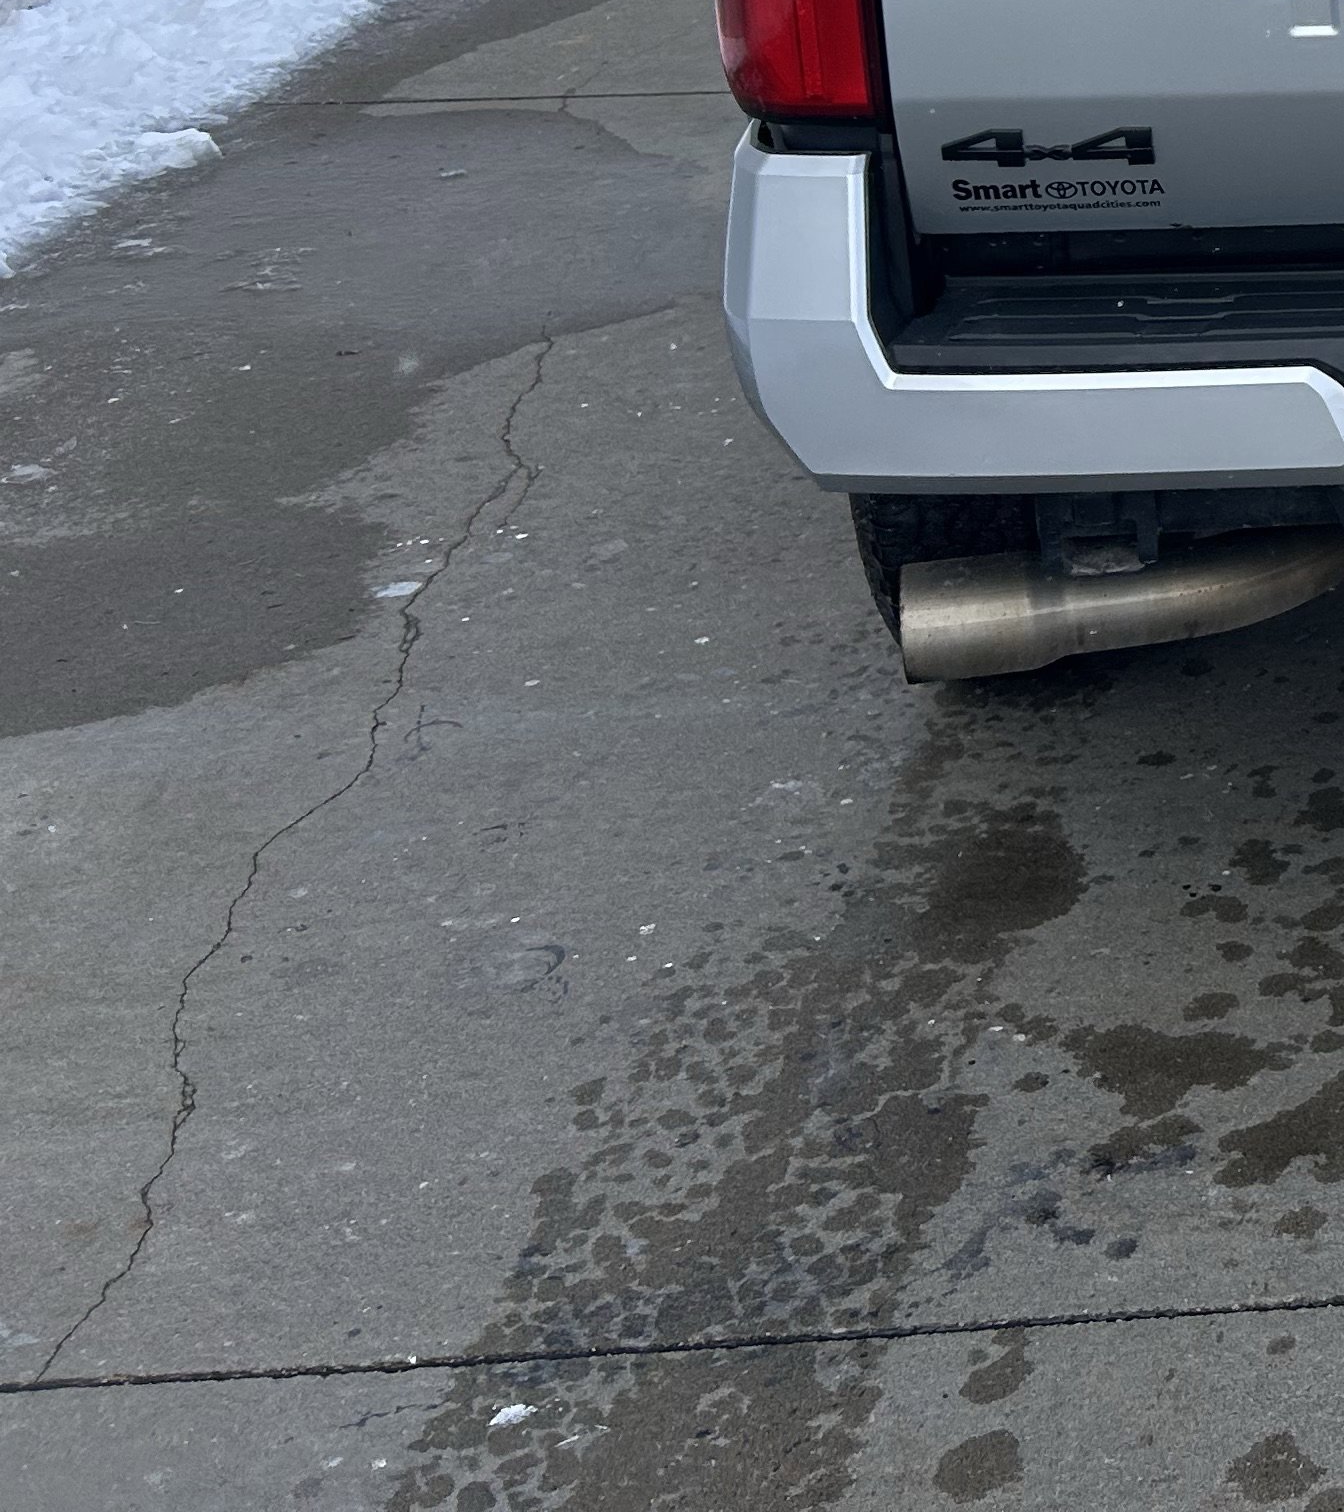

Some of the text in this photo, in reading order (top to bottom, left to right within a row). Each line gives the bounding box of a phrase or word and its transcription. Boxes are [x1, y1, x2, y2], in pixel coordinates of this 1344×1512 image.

[952, 178, 1165, 201] Smart TOYOTA
[959, 199, 1161, 213] www.smarttoyotaquadcities.com
